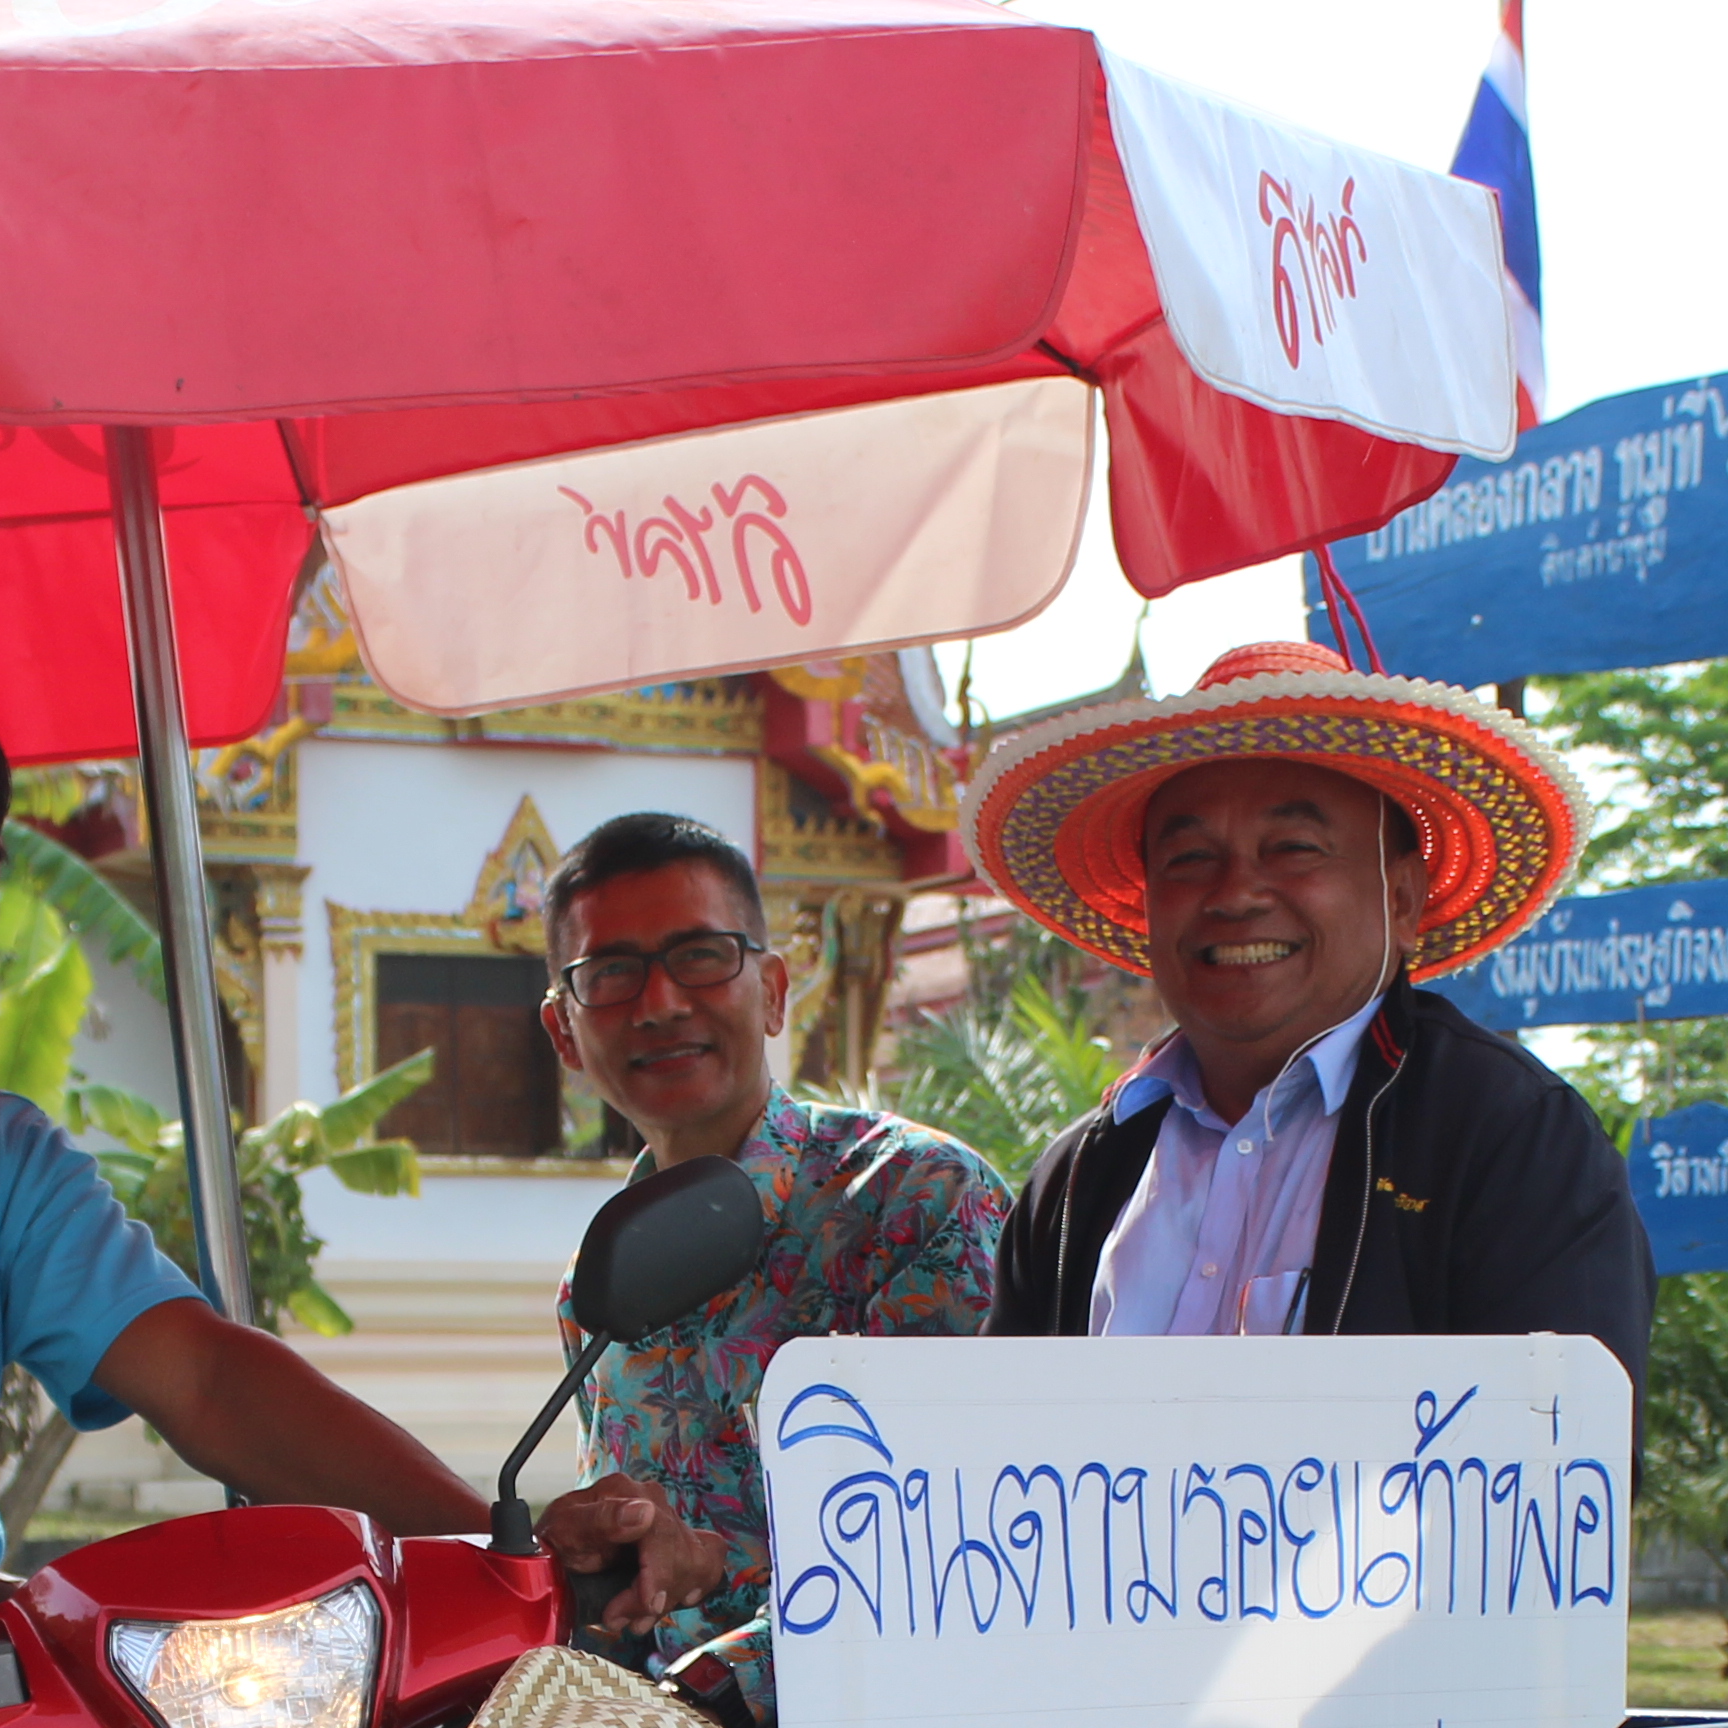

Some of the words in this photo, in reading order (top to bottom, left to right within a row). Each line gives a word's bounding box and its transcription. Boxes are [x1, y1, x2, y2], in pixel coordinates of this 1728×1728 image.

[766, 1381, 1614, 1639] เดินตามรอยเท้าพ่อ
